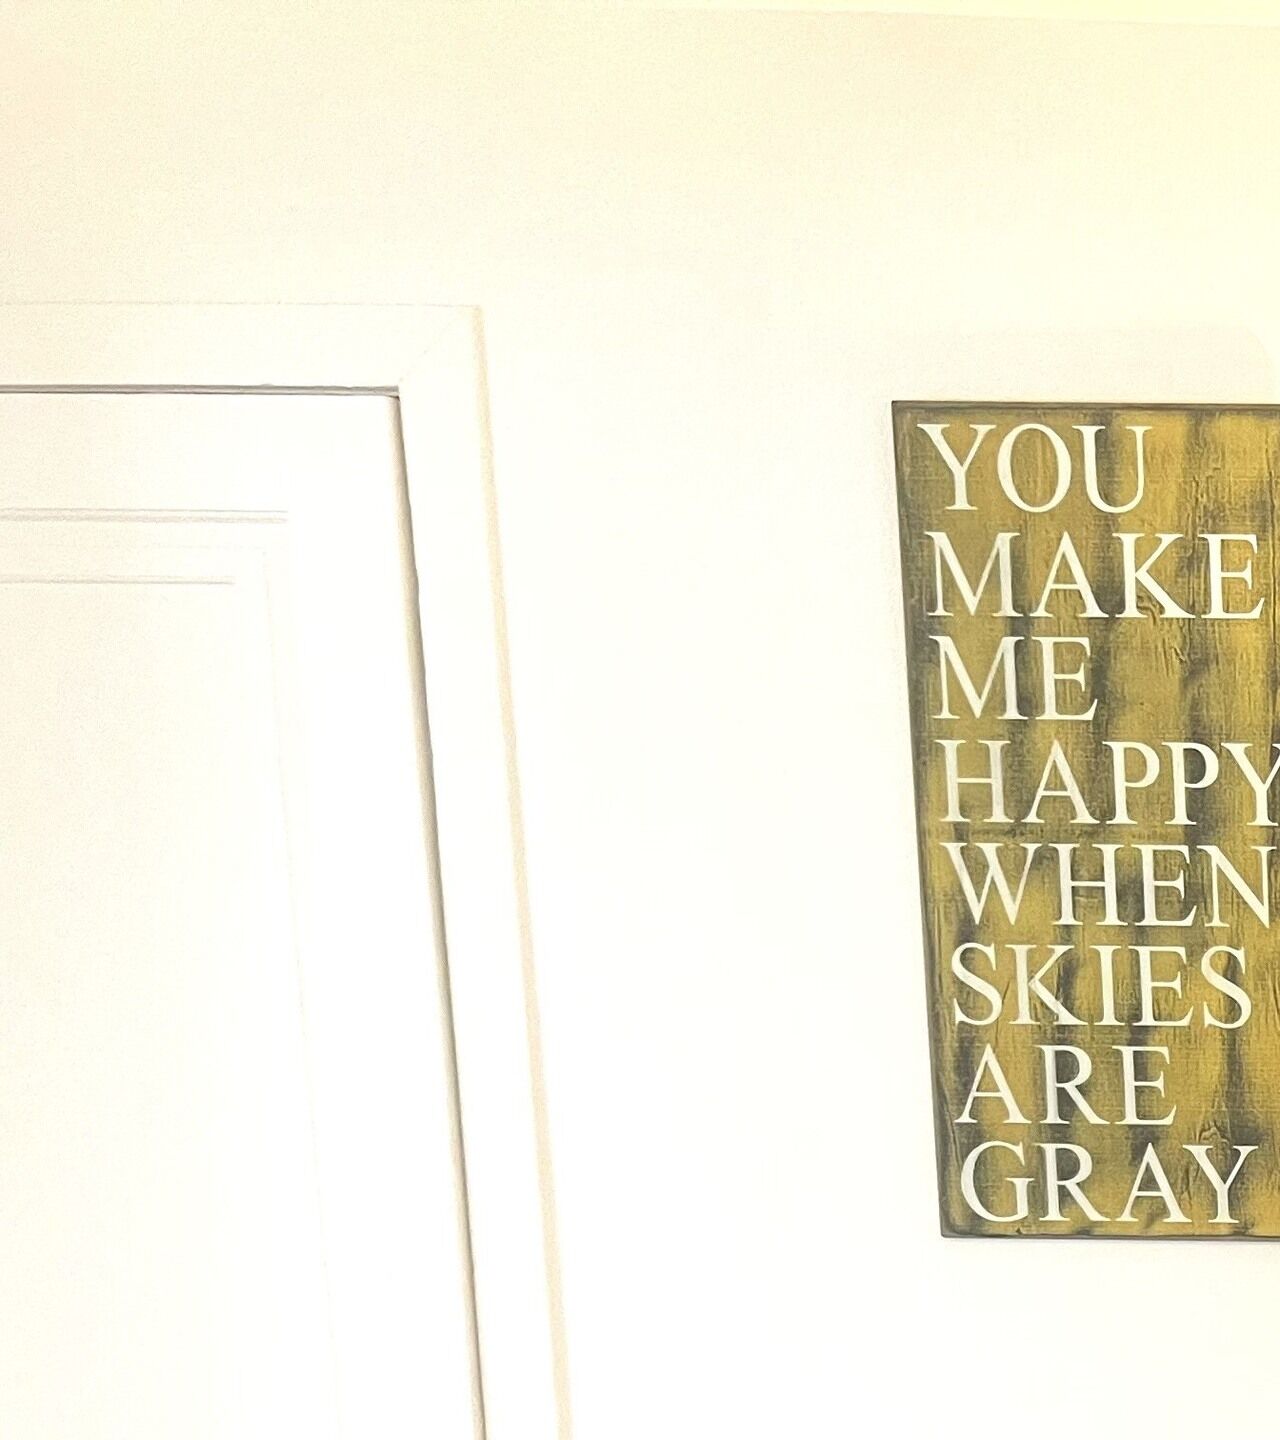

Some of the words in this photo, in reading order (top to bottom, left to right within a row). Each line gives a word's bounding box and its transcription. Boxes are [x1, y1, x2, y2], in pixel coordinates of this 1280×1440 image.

[917, 423, 1152, 513] YOU
[924, 531, 1265, 620] MAKE
[929, 636, 1098, 722] ME
[940, 842, 1276, 929] WHEN
[952, 942, 1252, 1028] SKIES
[955, 1044, 1177, 1127] ARE
[960, 1141, 1258, 1224] GRAY
